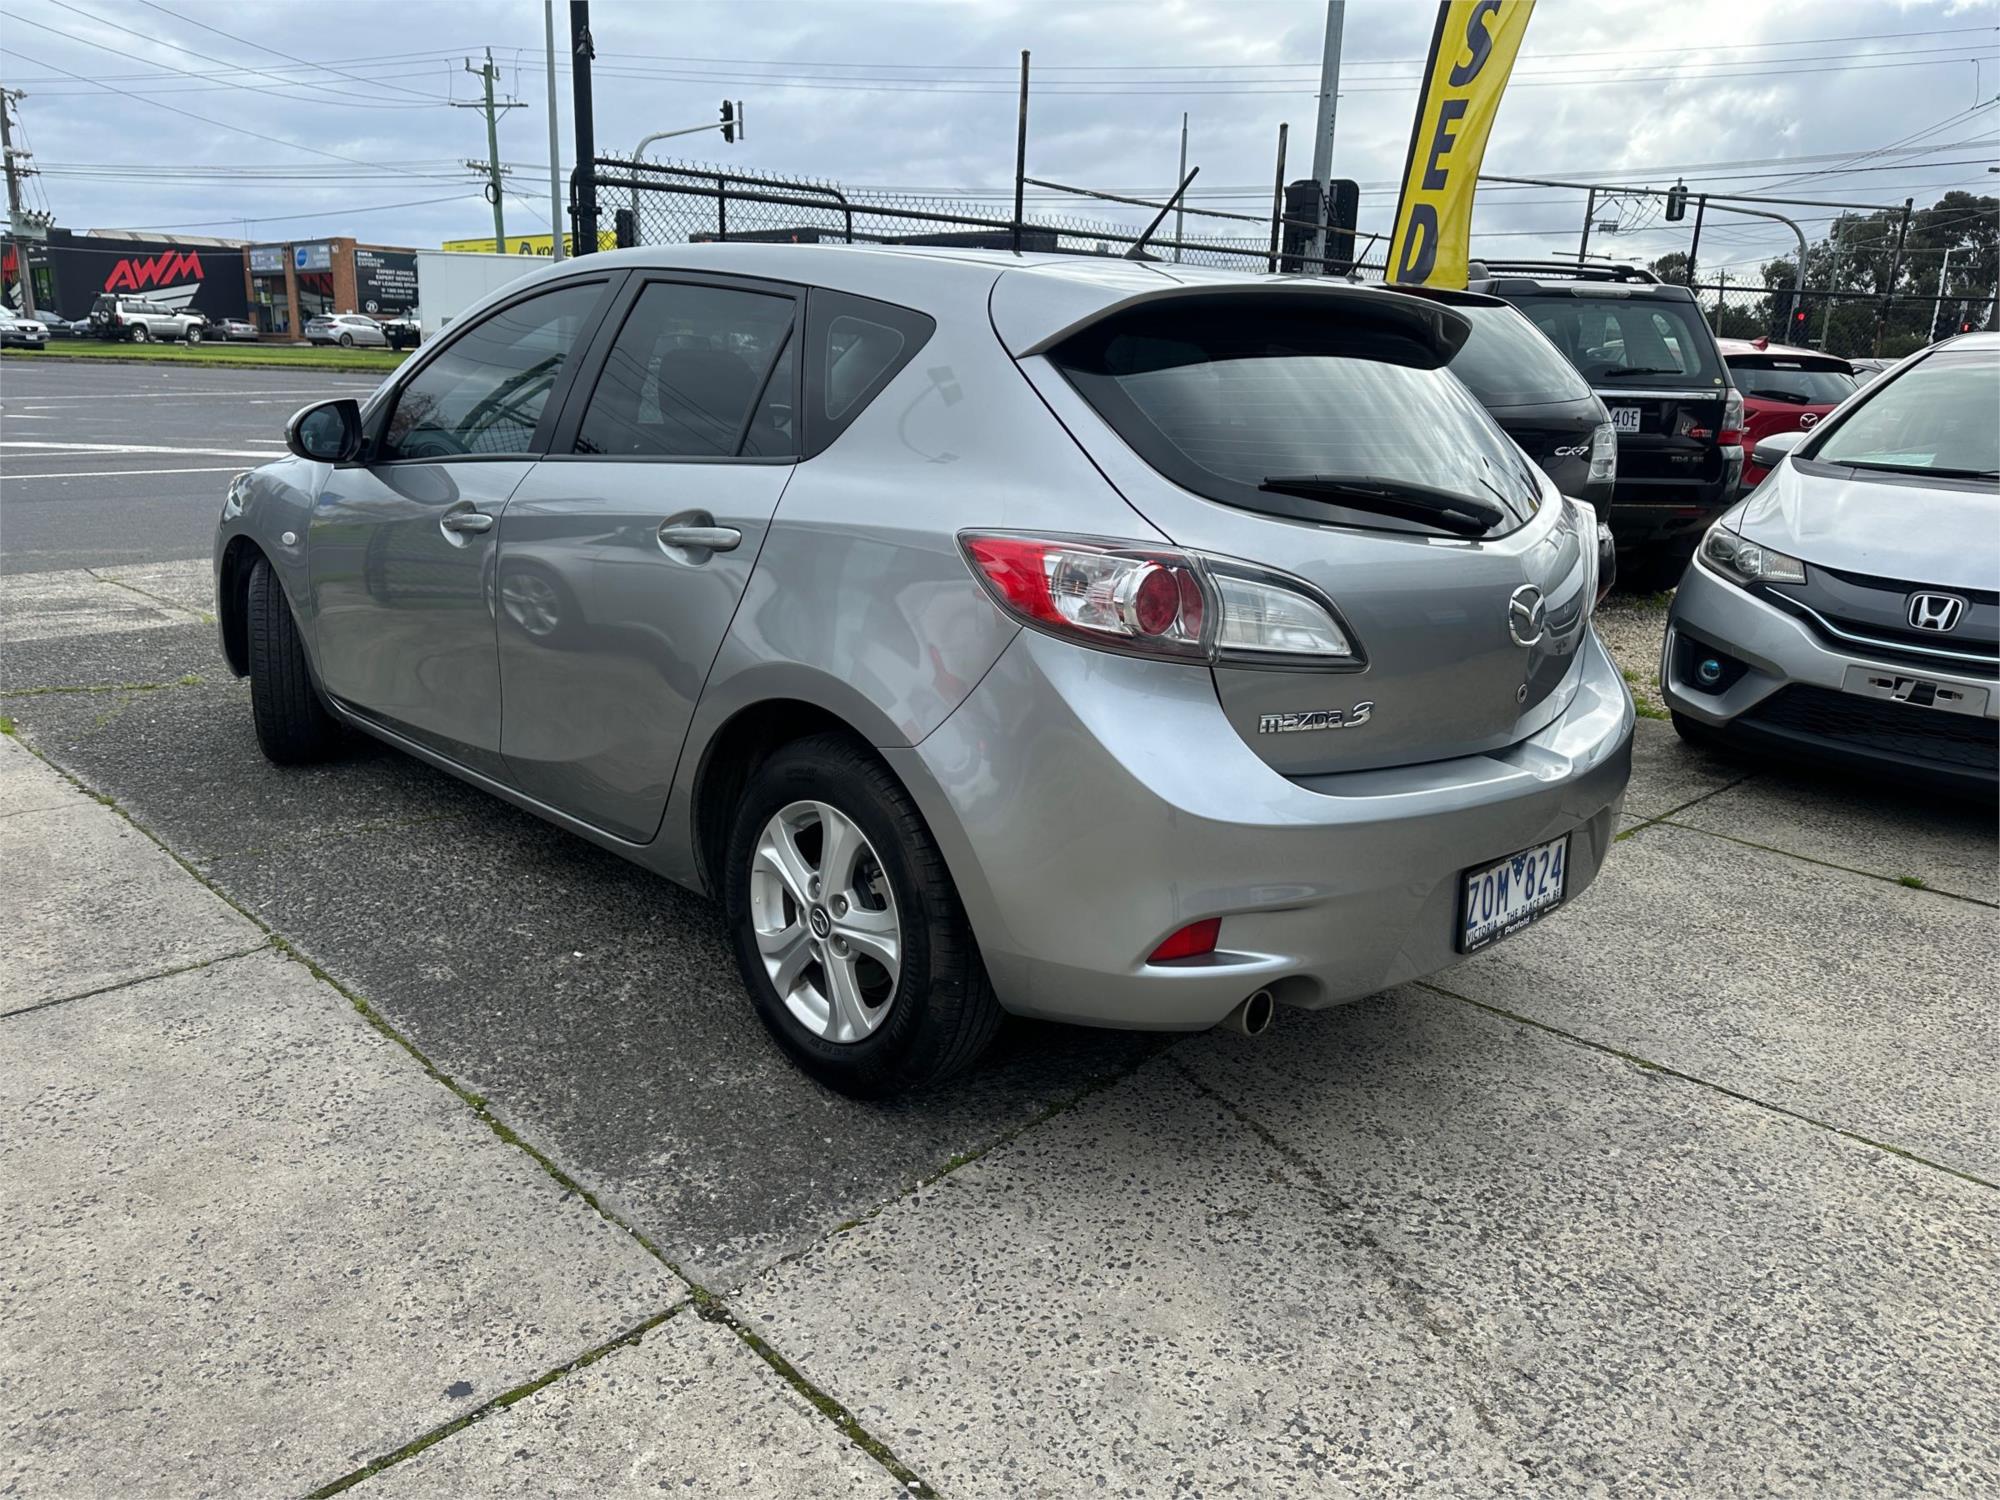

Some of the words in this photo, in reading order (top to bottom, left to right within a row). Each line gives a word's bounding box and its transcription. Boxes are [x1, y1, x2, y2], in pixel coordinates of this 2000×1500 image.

[104, 249, 205, 293] AWM
[1554, 446, 1590, 457] CX-7
[1344, 701, 1374, 728] 3
[1525, 844, 1564, 901] 824
[1466, 919, 1498, 943] VICTORIA
[1507, 909, 1518, 922] THE
[1522, 899, 1540, 915] PLACE
[1542, 893, 1551, 904] TO
[1553, 887, 1560, 899] BE
[1504, 914, 1530, 935] Penfold
